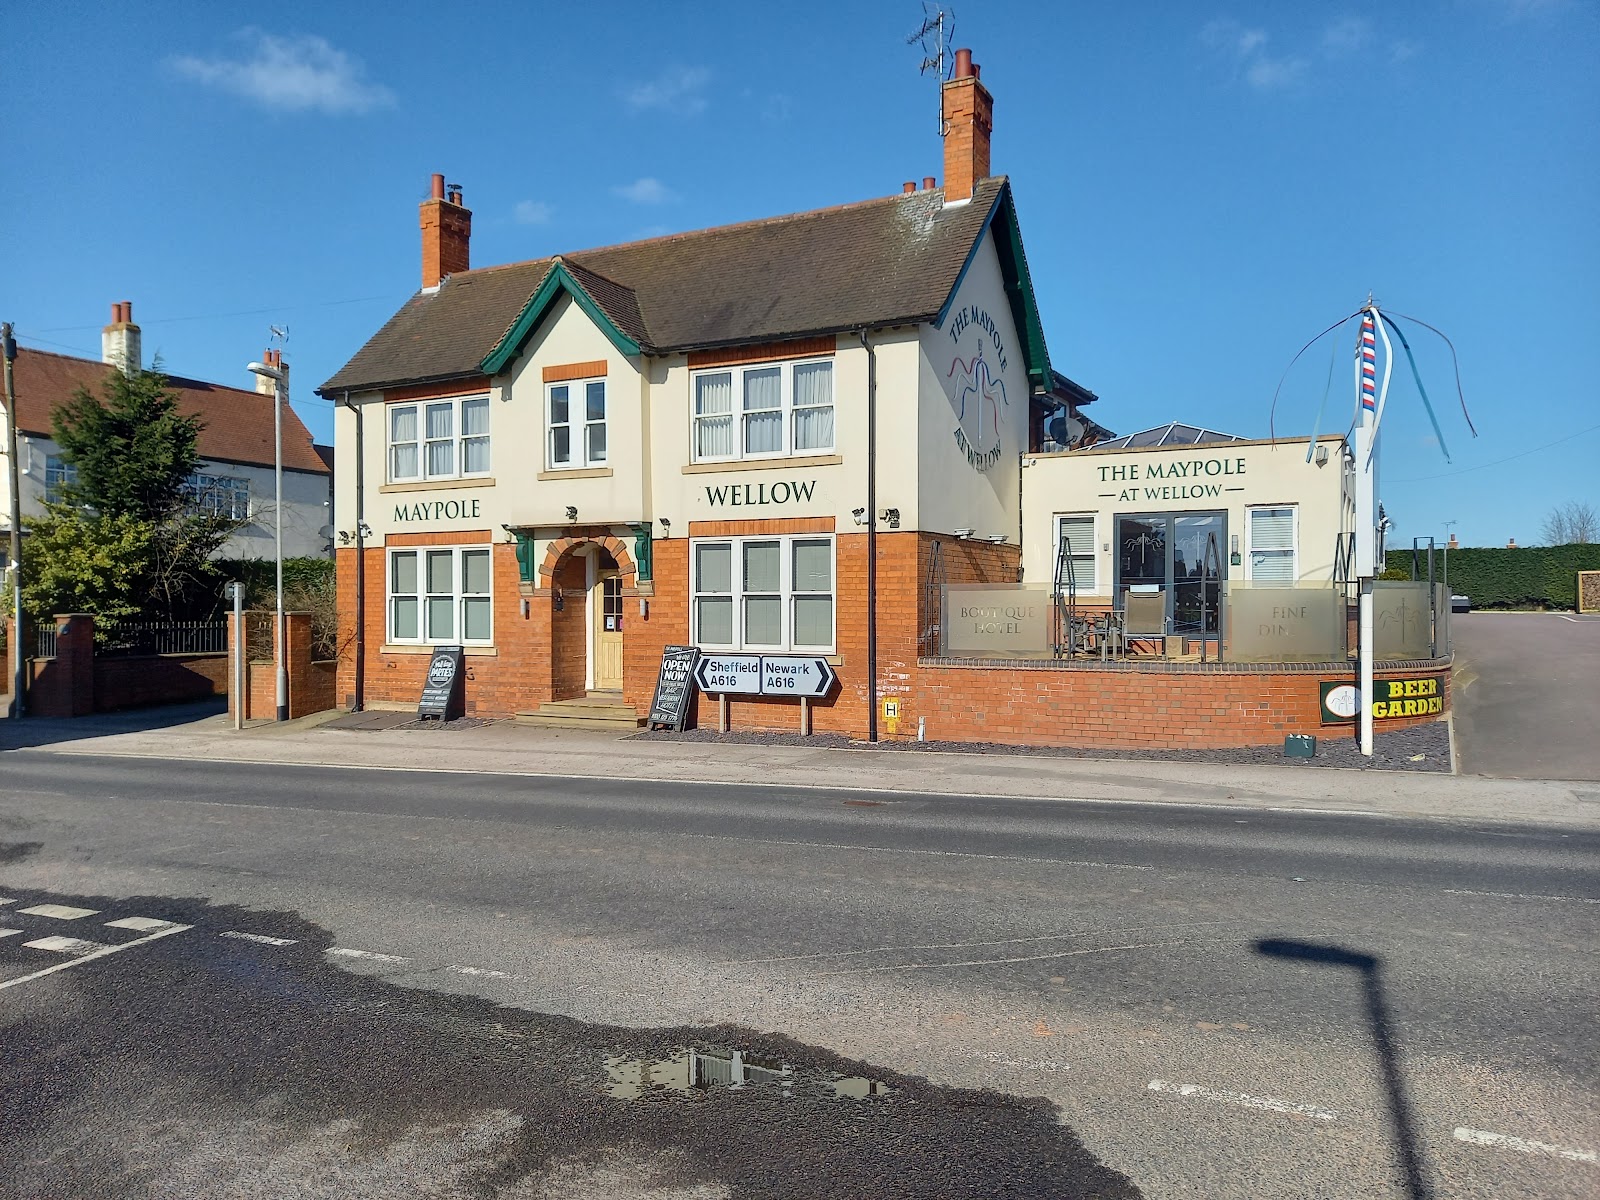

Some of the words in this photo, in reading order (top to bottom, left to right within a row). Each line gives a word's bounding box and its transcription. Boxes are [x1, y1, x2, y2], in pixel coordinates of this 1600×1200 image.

[949, 307, 969, 345] THE
[971, 304, 1008, 373] MAYPOLE
[966, 438, 1002, 472] WELLOW
[1097, 464, 1139, 482] THE
[1146, 457, 1246, 480] MAYPOLE
[705, 480, 818, 507] WELLOW
[1118, 488, 1140, 502] AT
[1144, 484, 1223, 500] WELLOW
[393, 499, 481, 523] MAYPOLE
[961, 606, 1035, 624] BOUTIQUE
[974, 622, 1022, 635] HOTEL
[663, 659, 691, 672] OPEN
[710, 661, 758, 673] Sheffield
[765, 662, 810, 675] Newark
[663, 670, 687, 682] NOW
[709, 675, 738, 687] A616
[766, 676, 795, 689] A616
[1388, 679, 1437, 699] BEER
[886, 703, 896, 716] H
[1372, 695, 1443, 718] GARDEN
